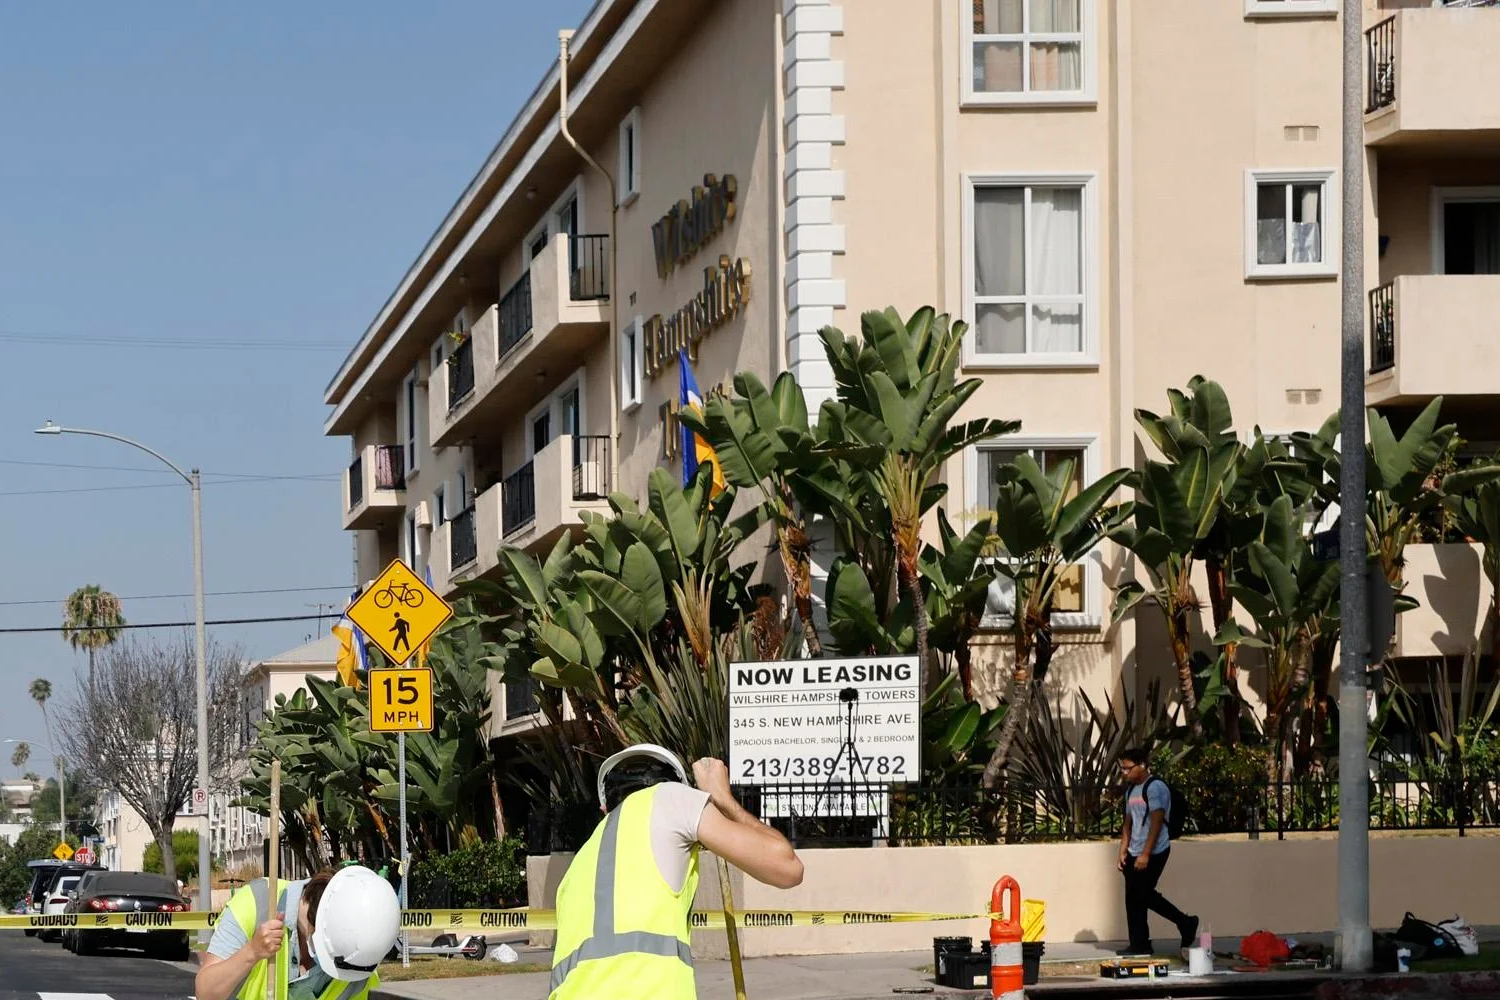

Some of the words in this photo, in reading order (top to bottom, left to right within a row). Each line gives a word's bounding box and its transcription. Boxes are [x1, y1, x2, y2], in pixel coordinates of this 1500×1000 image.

[737, 668, 793, 686] NOW
[803, 663, 911, 684] LEASING
[383, 677, 419, 705] 15
[733, 695, 788, 704] WILSHIRE
[792, 692, 860, 703] HAMPSH
[865, 690, 916, 700] TOWERS
[384, 711, 419, 723] MPH
[733, 718, 755, 728] 345
[759, 718, 770, 728] S.
[773, 717, 803, 727] NEW
[806, 714, 882, 726] HAMPSHIRE
[886, 713, 916, 724] AVE.
[733, 738, 772, 746] SPACIOUS
[867, 735, 872, 743] 2
[742, 756, 906, 777] 213/389-7782
[30, 915, 77, 926] CUIDADO
[126, 912, 172, 926] CAUTION
[480, 912, 527, 927] CAUTION
[744, 912, 794, 927] CUIDADO
[843, 912, 892, 924] CAUTION
